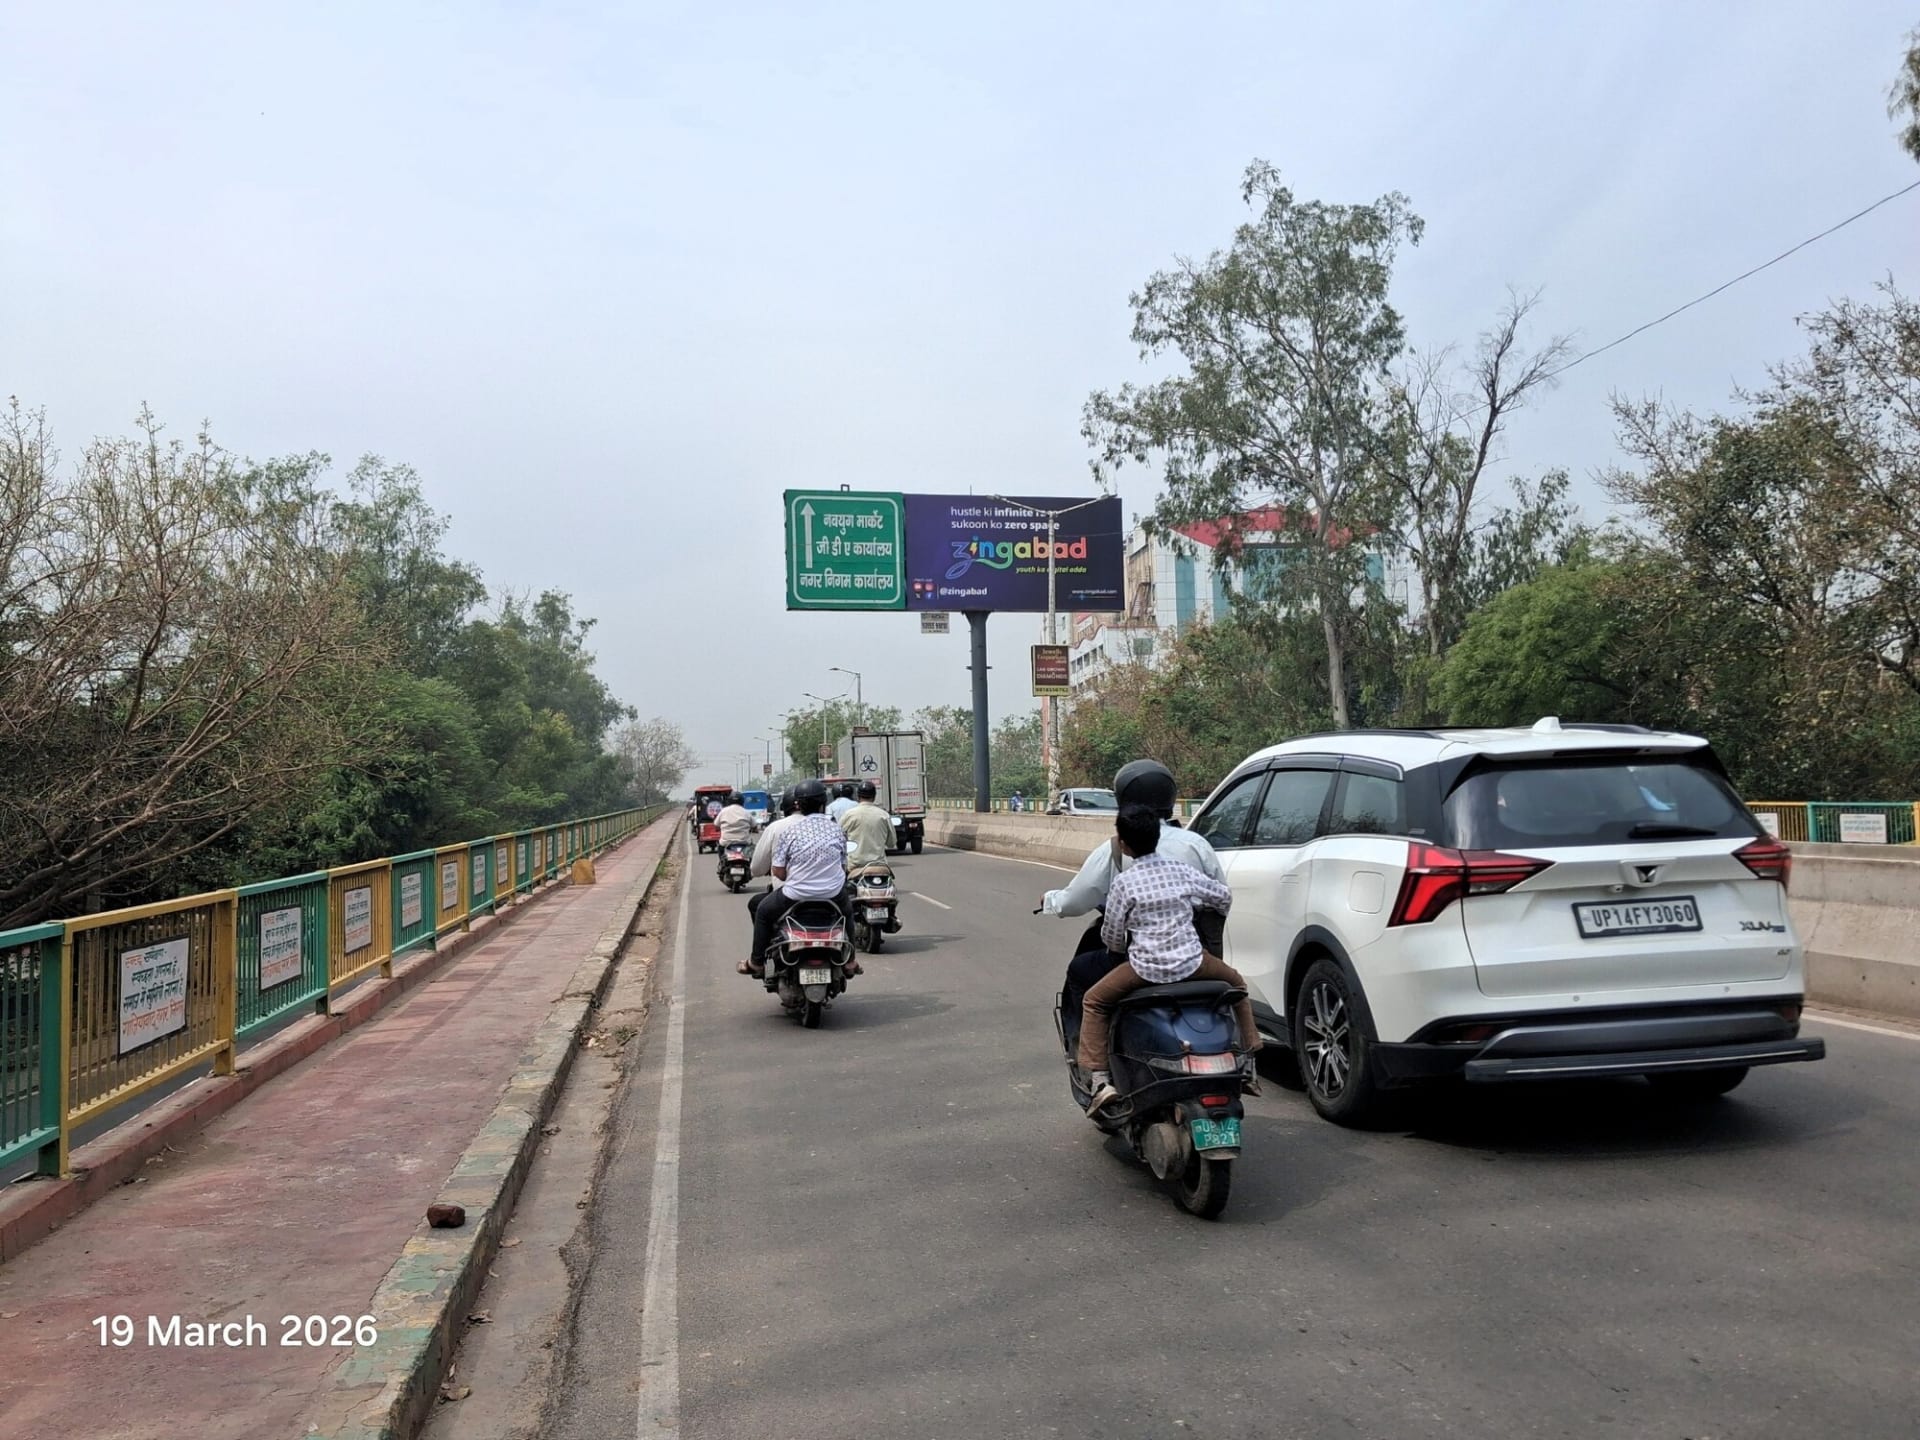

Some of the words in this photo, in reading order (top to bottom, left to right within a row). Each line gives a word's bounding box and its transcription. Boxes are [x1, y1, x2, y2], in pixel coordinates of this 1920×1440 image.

[824, 514, 854, 535] नवयुग
[856, 510, 883, 529] मार्केट
[951, 507, 981, 517] hustle
[984, 507, 992, 517] ki
[995, 507, 1033, 517] infinite
[951, 520, 988, 528] sukoon
[990, 520, 1002, 528] ko
[1004, 521, 1027, 529] zero
[1029, 522, 1060, 532] spae
[816, 536, 829, 554] जी
[832, 536, 841, 556] डी
[844, 542, 851, 556] ए
[853, 537, 893, 556] कार्यालय
[945, 535, 1087, 580] zingabad
[800, 573, 823, 588] नगर
[824, 568, 852, 588] निगम
[854, 568, 894, 590] कार्यालय
[940, 587, 987, 597] @zingabad
[1592, 904, 1694, 927] UP14FY3060
